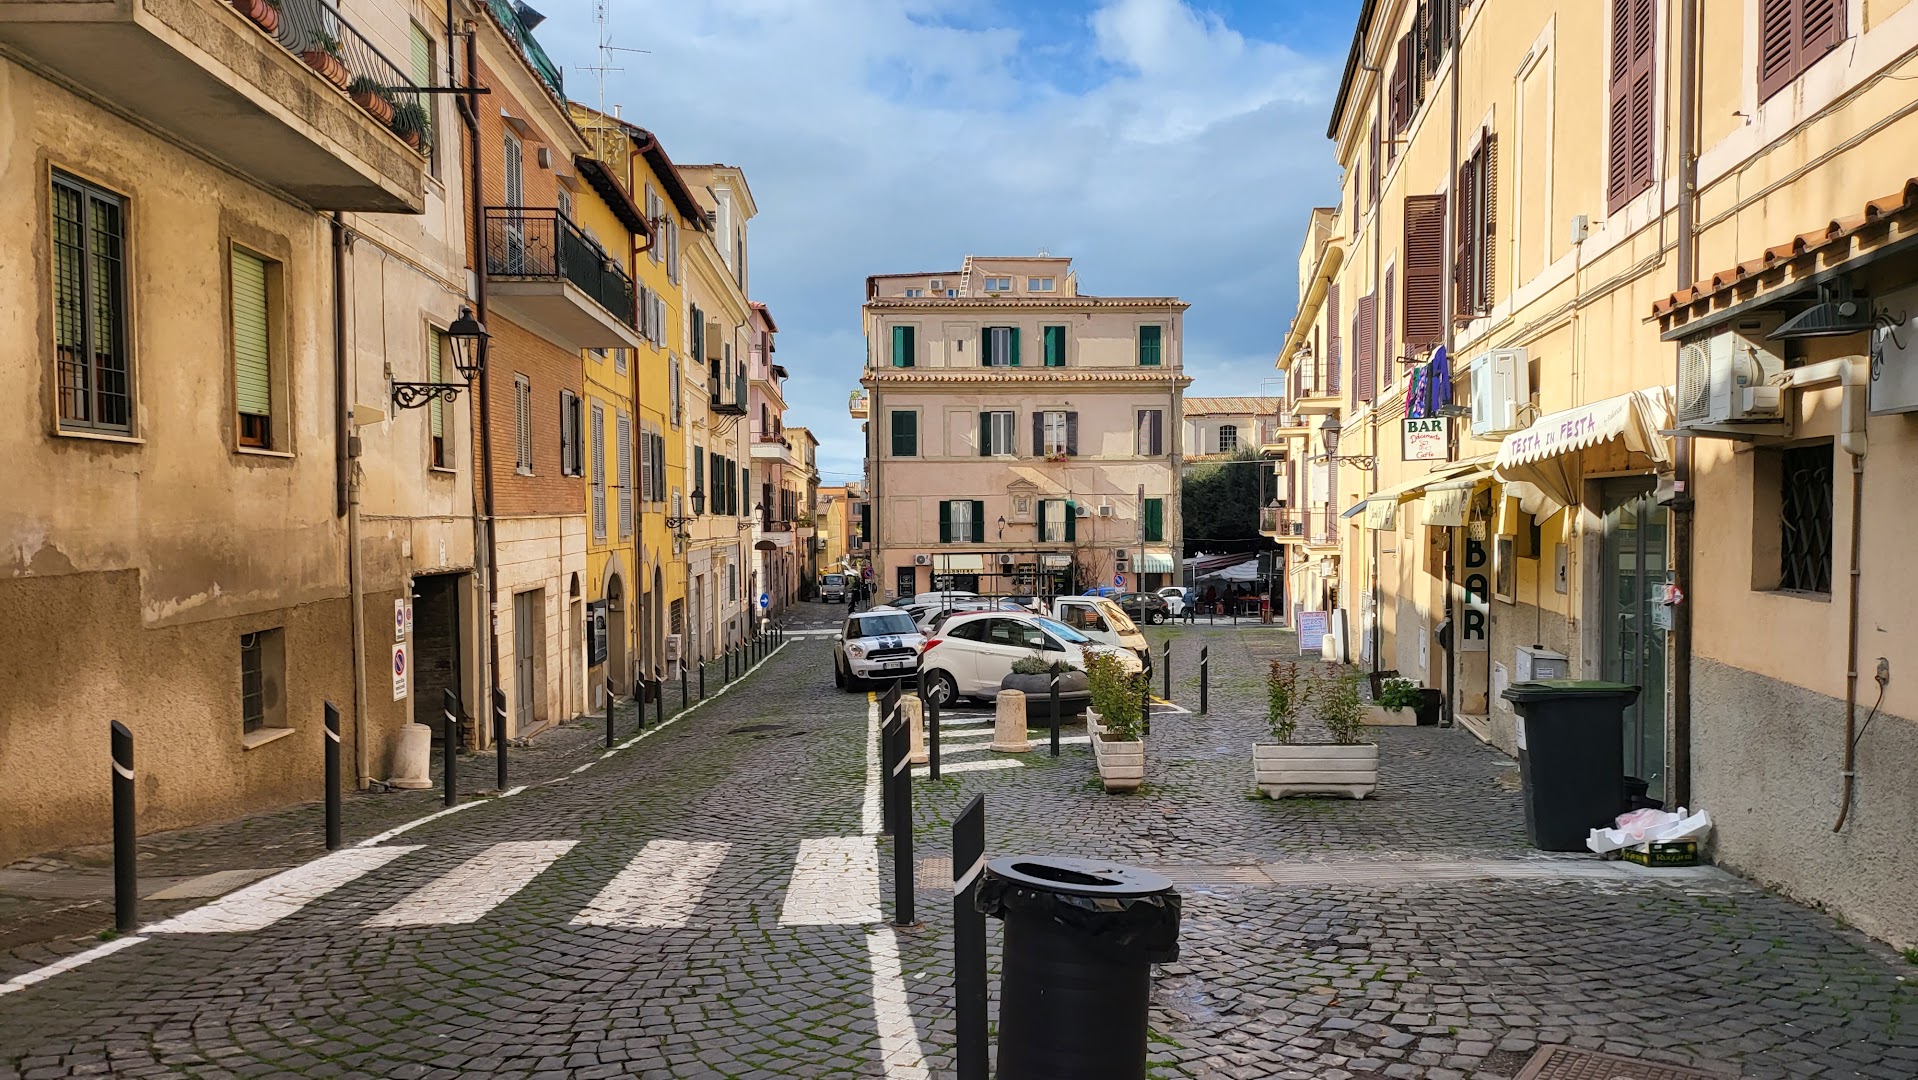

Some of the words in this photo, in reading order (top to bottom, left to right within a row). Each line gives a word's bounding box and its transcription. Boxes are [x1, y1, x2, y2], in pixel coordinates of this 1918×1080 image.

[1407, 420, 1443, 433] BAR
[1511, 431, 1541, 456] TESTA
[1546, 431, 1556, 446] IN
[1560, 412, 1595, 440] FESTA
[1463, 537, 1488, 640] BAR
